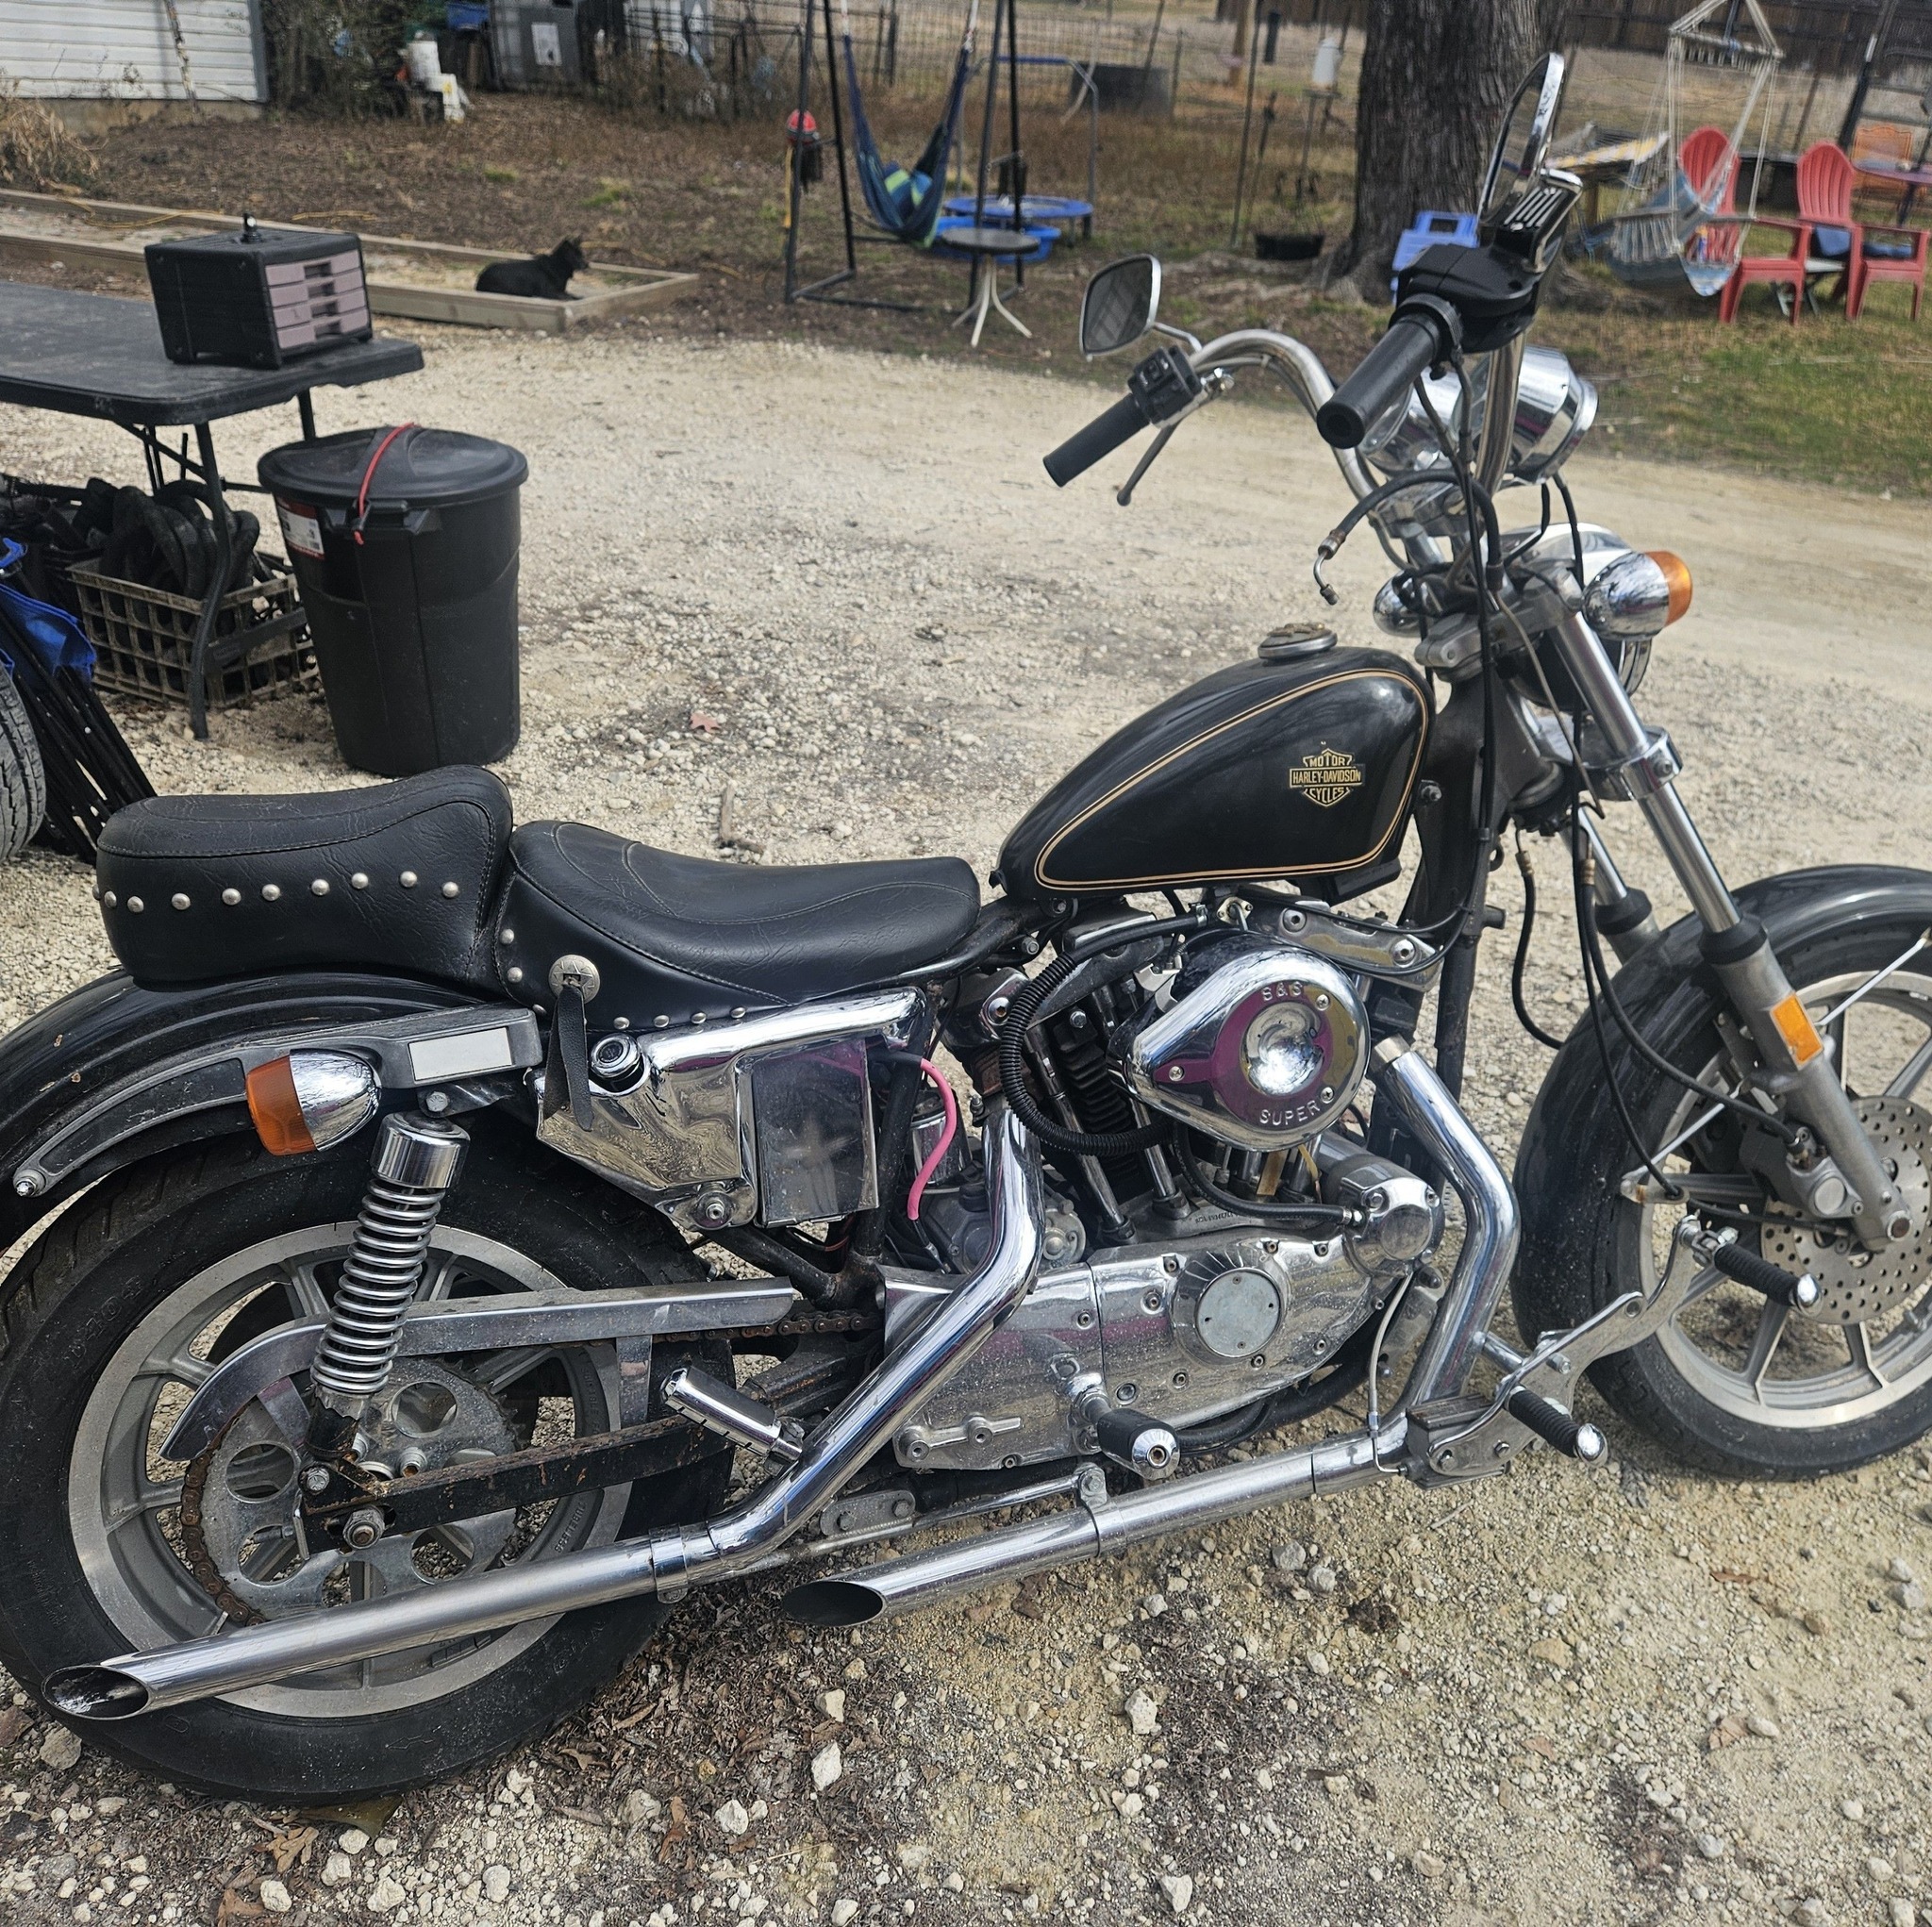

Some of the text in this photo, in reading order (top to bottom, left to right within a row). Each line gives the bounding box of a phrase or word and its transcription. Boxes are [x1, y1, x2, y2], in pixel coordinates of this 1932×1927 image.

[1309, 754, 1345, 768] MOTOR
[1292, 769, 1361, 784] HARLEY-DAVIDSON
[1309, 787, 1344, 804] CYCLES
[1261, 981, 1303, 1002] S&S
[1259, 1100, 1321, 1126] SUPER
